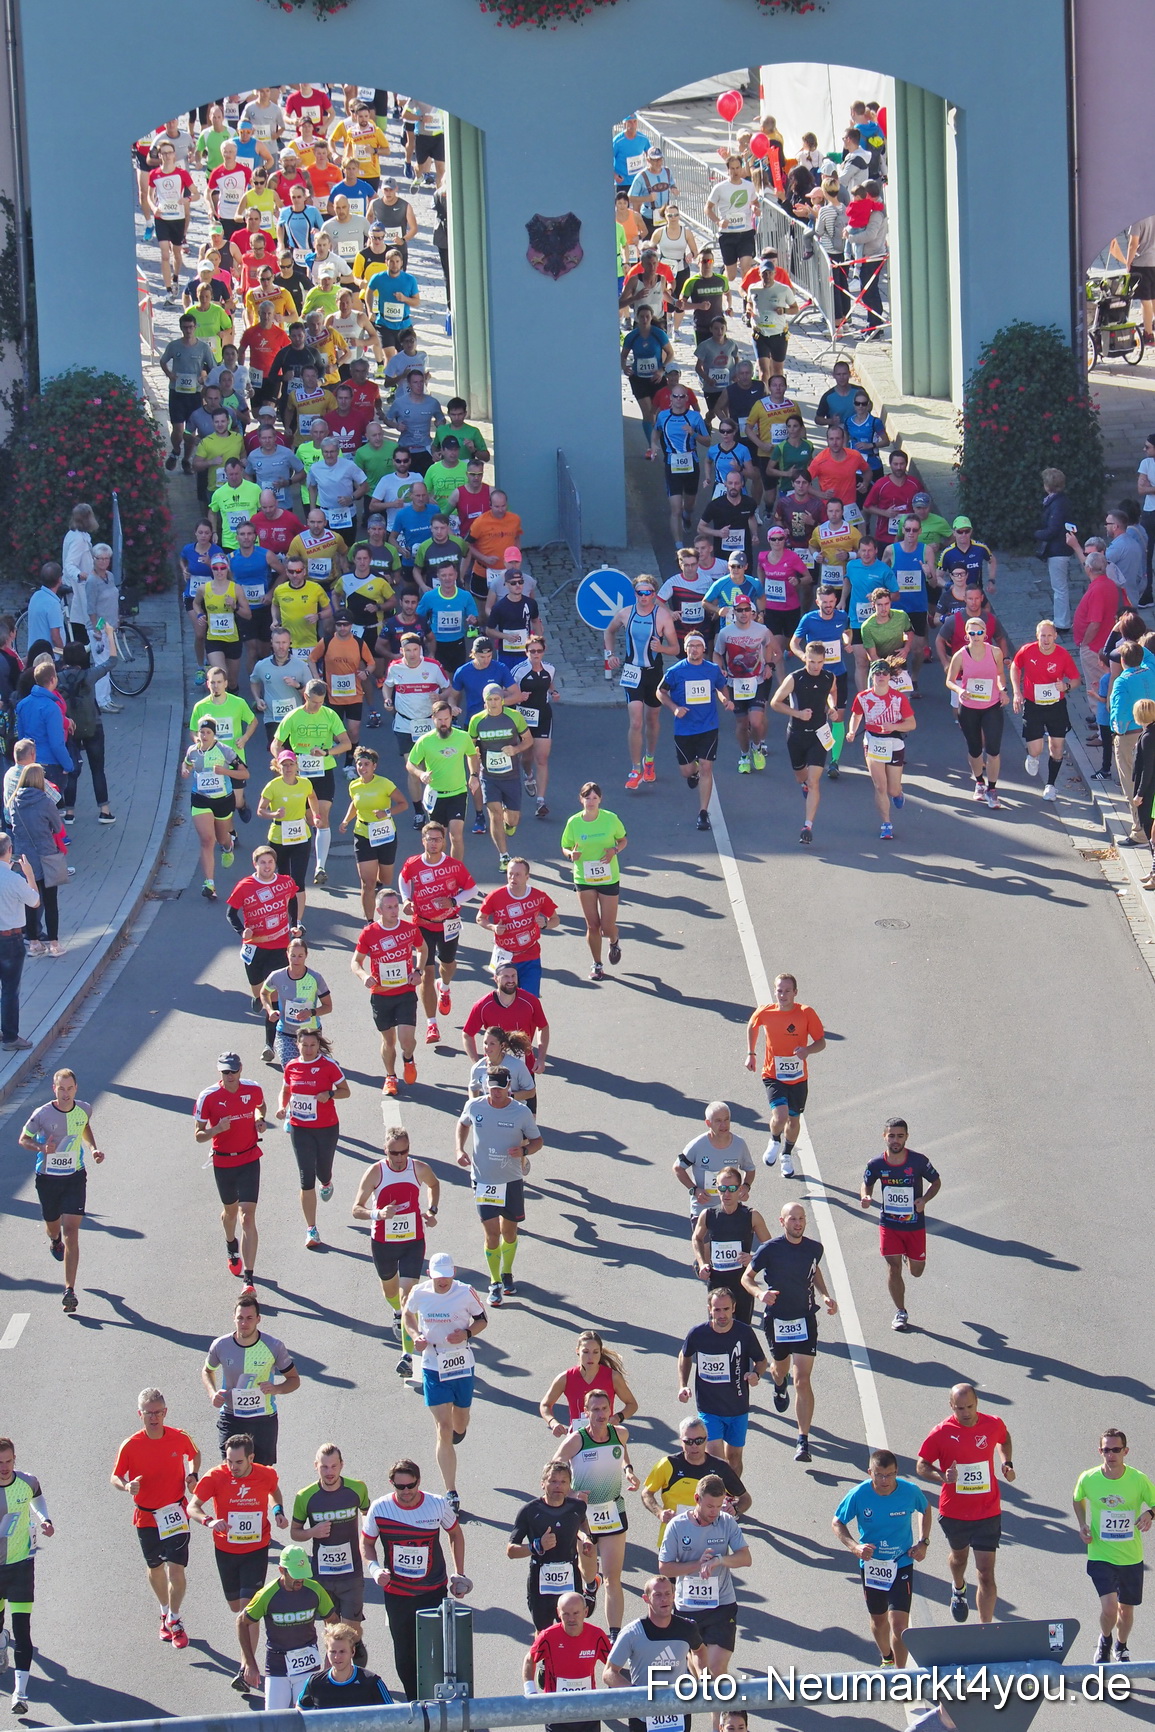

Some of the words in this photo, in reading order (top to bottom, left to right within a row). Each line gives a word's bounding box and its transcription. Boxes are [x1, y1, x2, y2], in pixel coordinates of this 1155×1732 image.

[386, 307, 401, 315] 2604
[230, 515, 247, 523] 2290
[725, 535, 742, 543] 2354
[311, 563, 327, 571] 2421
[369, 560, 389, 568] OCK
[824, 570, 840, 579] 2399
[767, 585, 783, 593] 2188
[215, 619, 229, 627] 142
[441, 617, 459, 625] 2115
[336, 680, 351, 688] 330
[974, 684, 984, 692] 95
[691, 686, 705, 694] 319
[276, 704, 294, 714] 2263
[414, 724, 432, 733] 2320
[479, 728, 513, 738] BOCK
[873, 745, 886, 753] 325
[302, 760, 321, 768] 2322
[489, 756, 507, 766] 2531
[201, 778, 220, 787] 2235
[288, 827, 302, 835] 294
[372, 826, 390, 836] 2552
[590, 866, 605, 876] 153
[386, 968, 401, 977] 112
[779, 1062, 800, 1071] 2537
[293, 1100, 312, 1110] 2304
[51, 1157, 73, 1166] 3084
[485, 1185, 497, 1195] 28
[888, 1194, 909, 1203] 3065
[392, 1221, 409, 1231] 270
[715, 1250, 737, 1259] 2160
[778, 1324, 802, 1333] 2383
[443, 1356, 465, 1369] 2008
[702, 1361, 725, 1372] 2392
[237, 1396, 261, 1406] 2232
[963, 1471, 983, 1482] 253
[163, 1512, 182, 1525] 158
[311, 1507, 357, 1522] BOCK
[593, 1511, 610, 1522] 241
[239, 1521, 252, 1531] 80
[1105, 1518, 1130, 1529] 2172
[322, 1552, 347, 1562] 2532
[398, 1553, 423, 1565] 2519
[544, 1571, 569, 1582] 3057
[868, 1566, 893, 1578] 2308
[688, 1586, 713, 1596] 2131
[271, 1609, 315, 1623] BOCK
[291, 1654, 316, 1669] 2526
[651, 1658, 680, 1667] adidas
[651, 1713, 679, 1725] 3036
